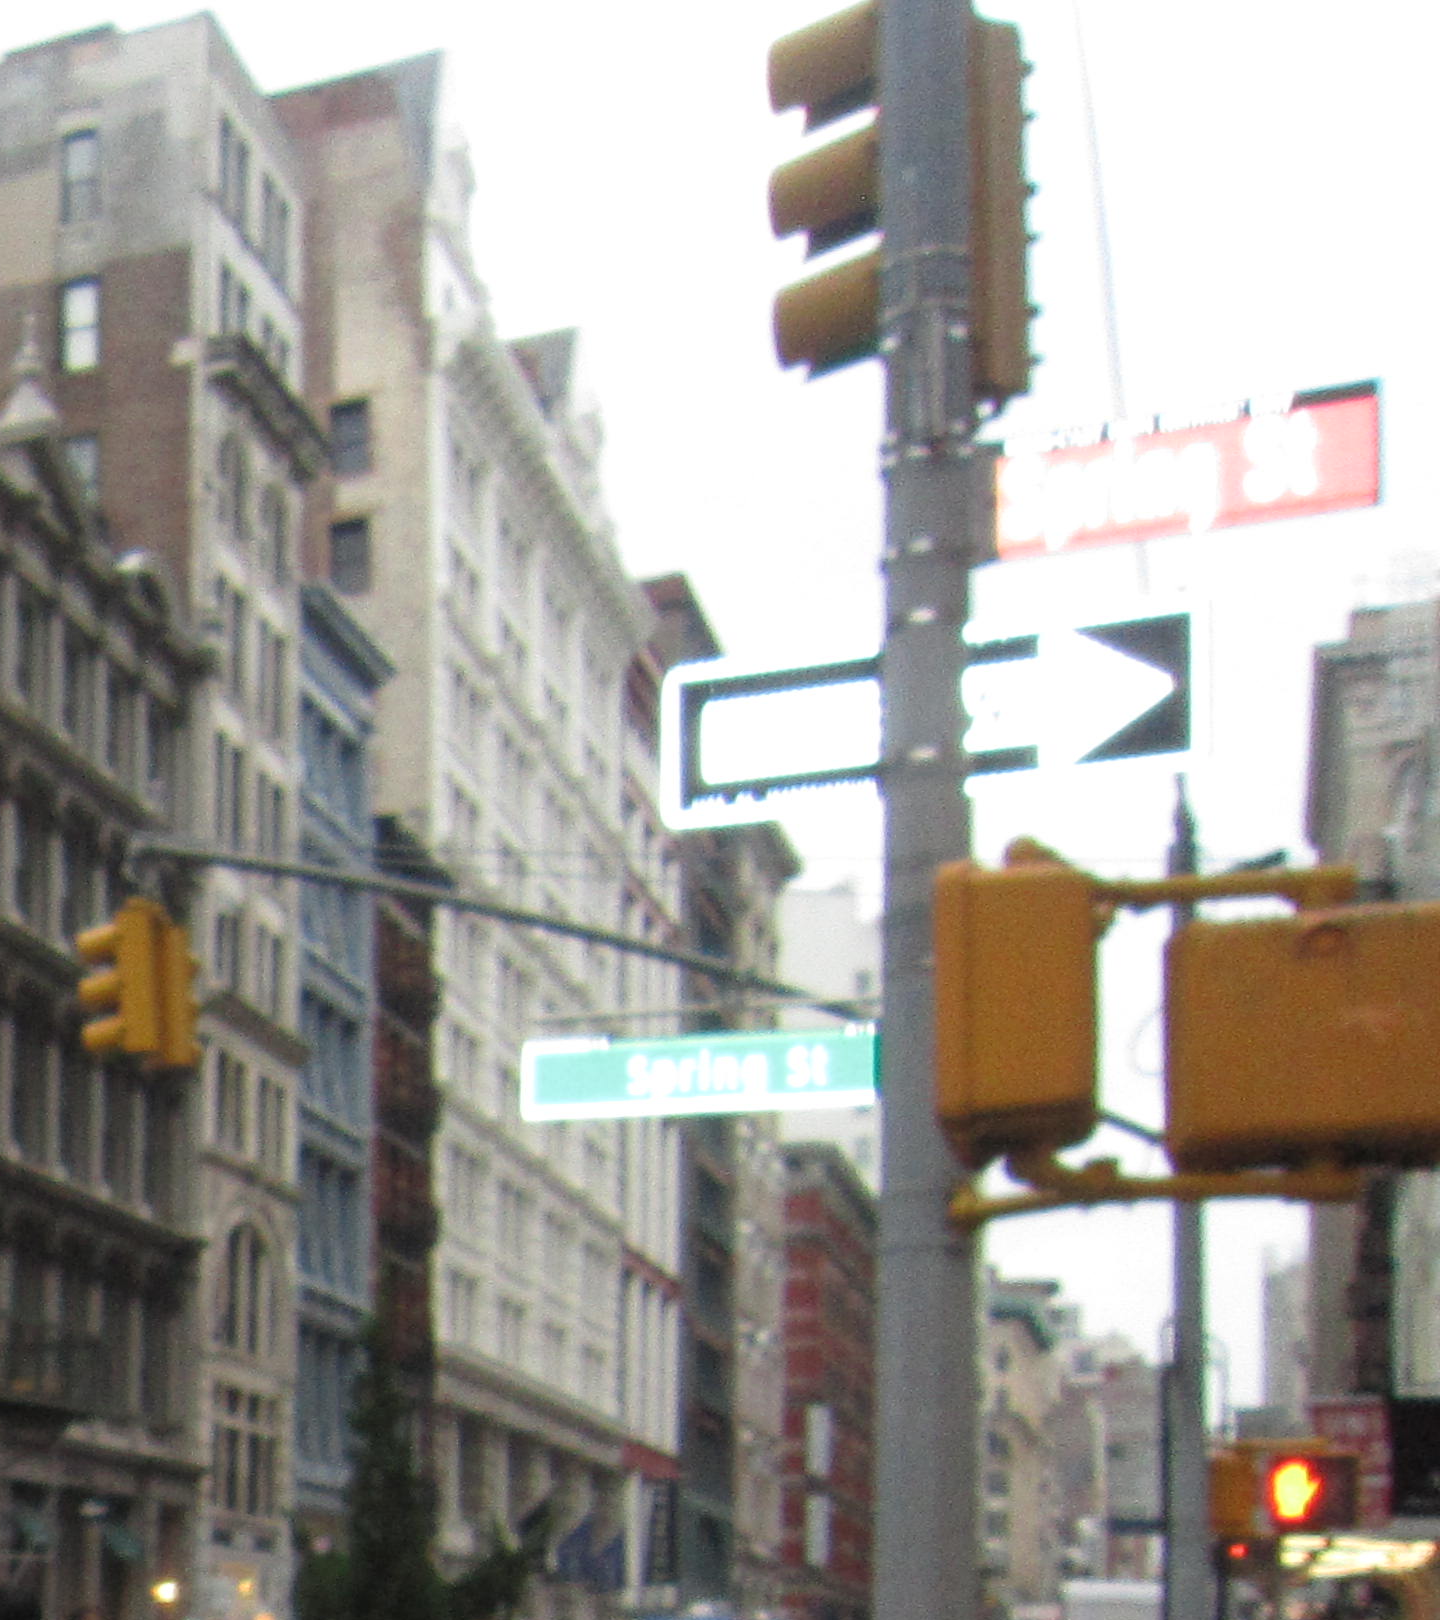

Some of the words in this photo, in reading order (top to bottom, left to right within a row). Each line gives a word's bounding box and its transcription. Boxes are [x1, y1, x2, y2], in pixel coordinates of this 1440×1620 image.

[1243, 410, 1318, 502] St
[627, 1048, 767, 1100] Spring
[787, 1044, 829, 1089] St
